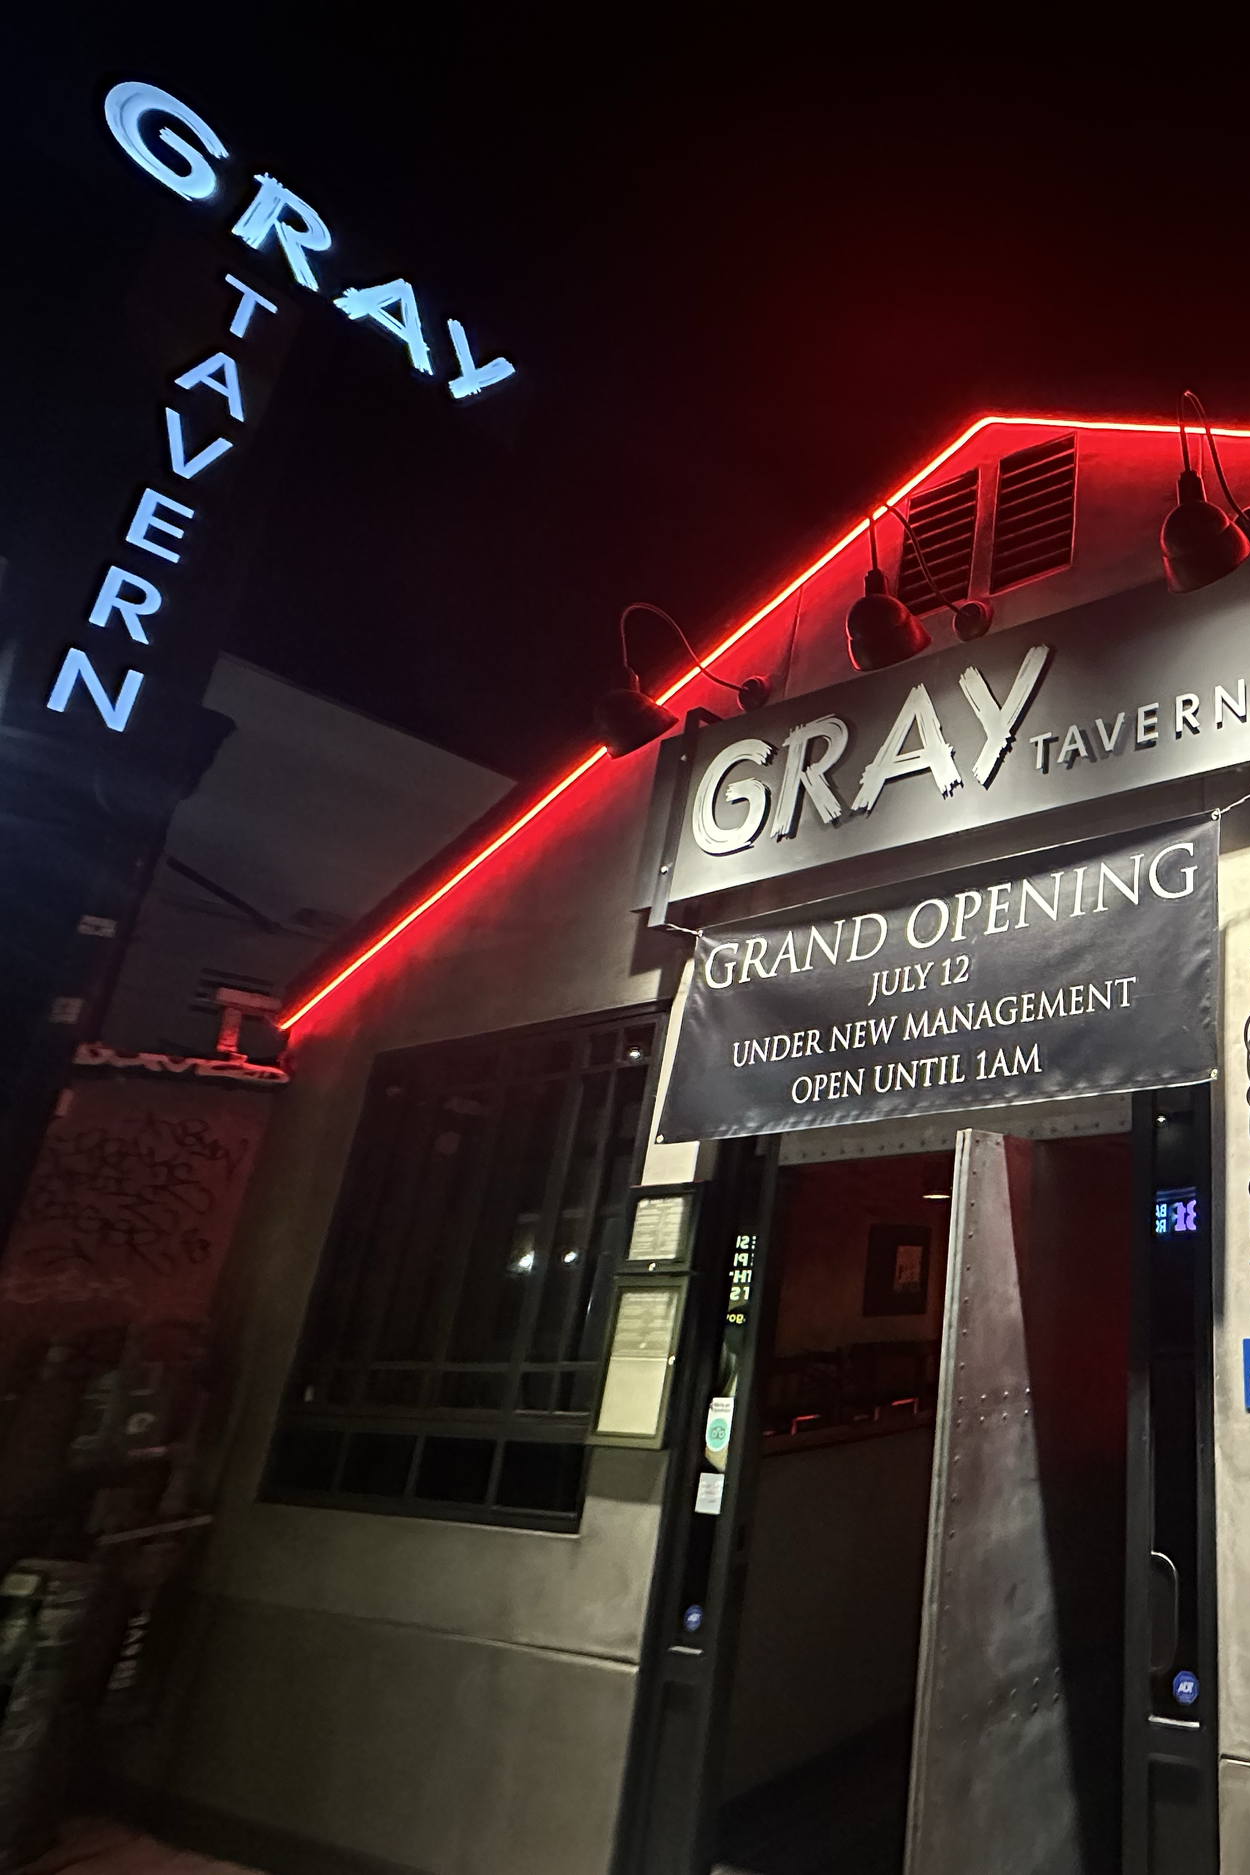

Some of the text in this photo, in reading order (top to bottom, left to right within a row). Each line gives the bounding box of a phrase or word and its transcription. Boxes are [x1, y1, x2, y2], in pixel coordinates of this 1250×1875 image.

[104, 81, 517, 399] GRAY
[47, 273, 279, 733] TAVERN
[691, 643, 1249, 857] GRAY TAVERN
[703, 842, 1198, 991] GRAND OPENING
[867, 954, 971, 1006] JULY 12
[732, 976, 1137, 1068] UNDER NEW MANAGEMENT
[791, 1044, 1043, 1105] OPEN UNTIL 1AM
